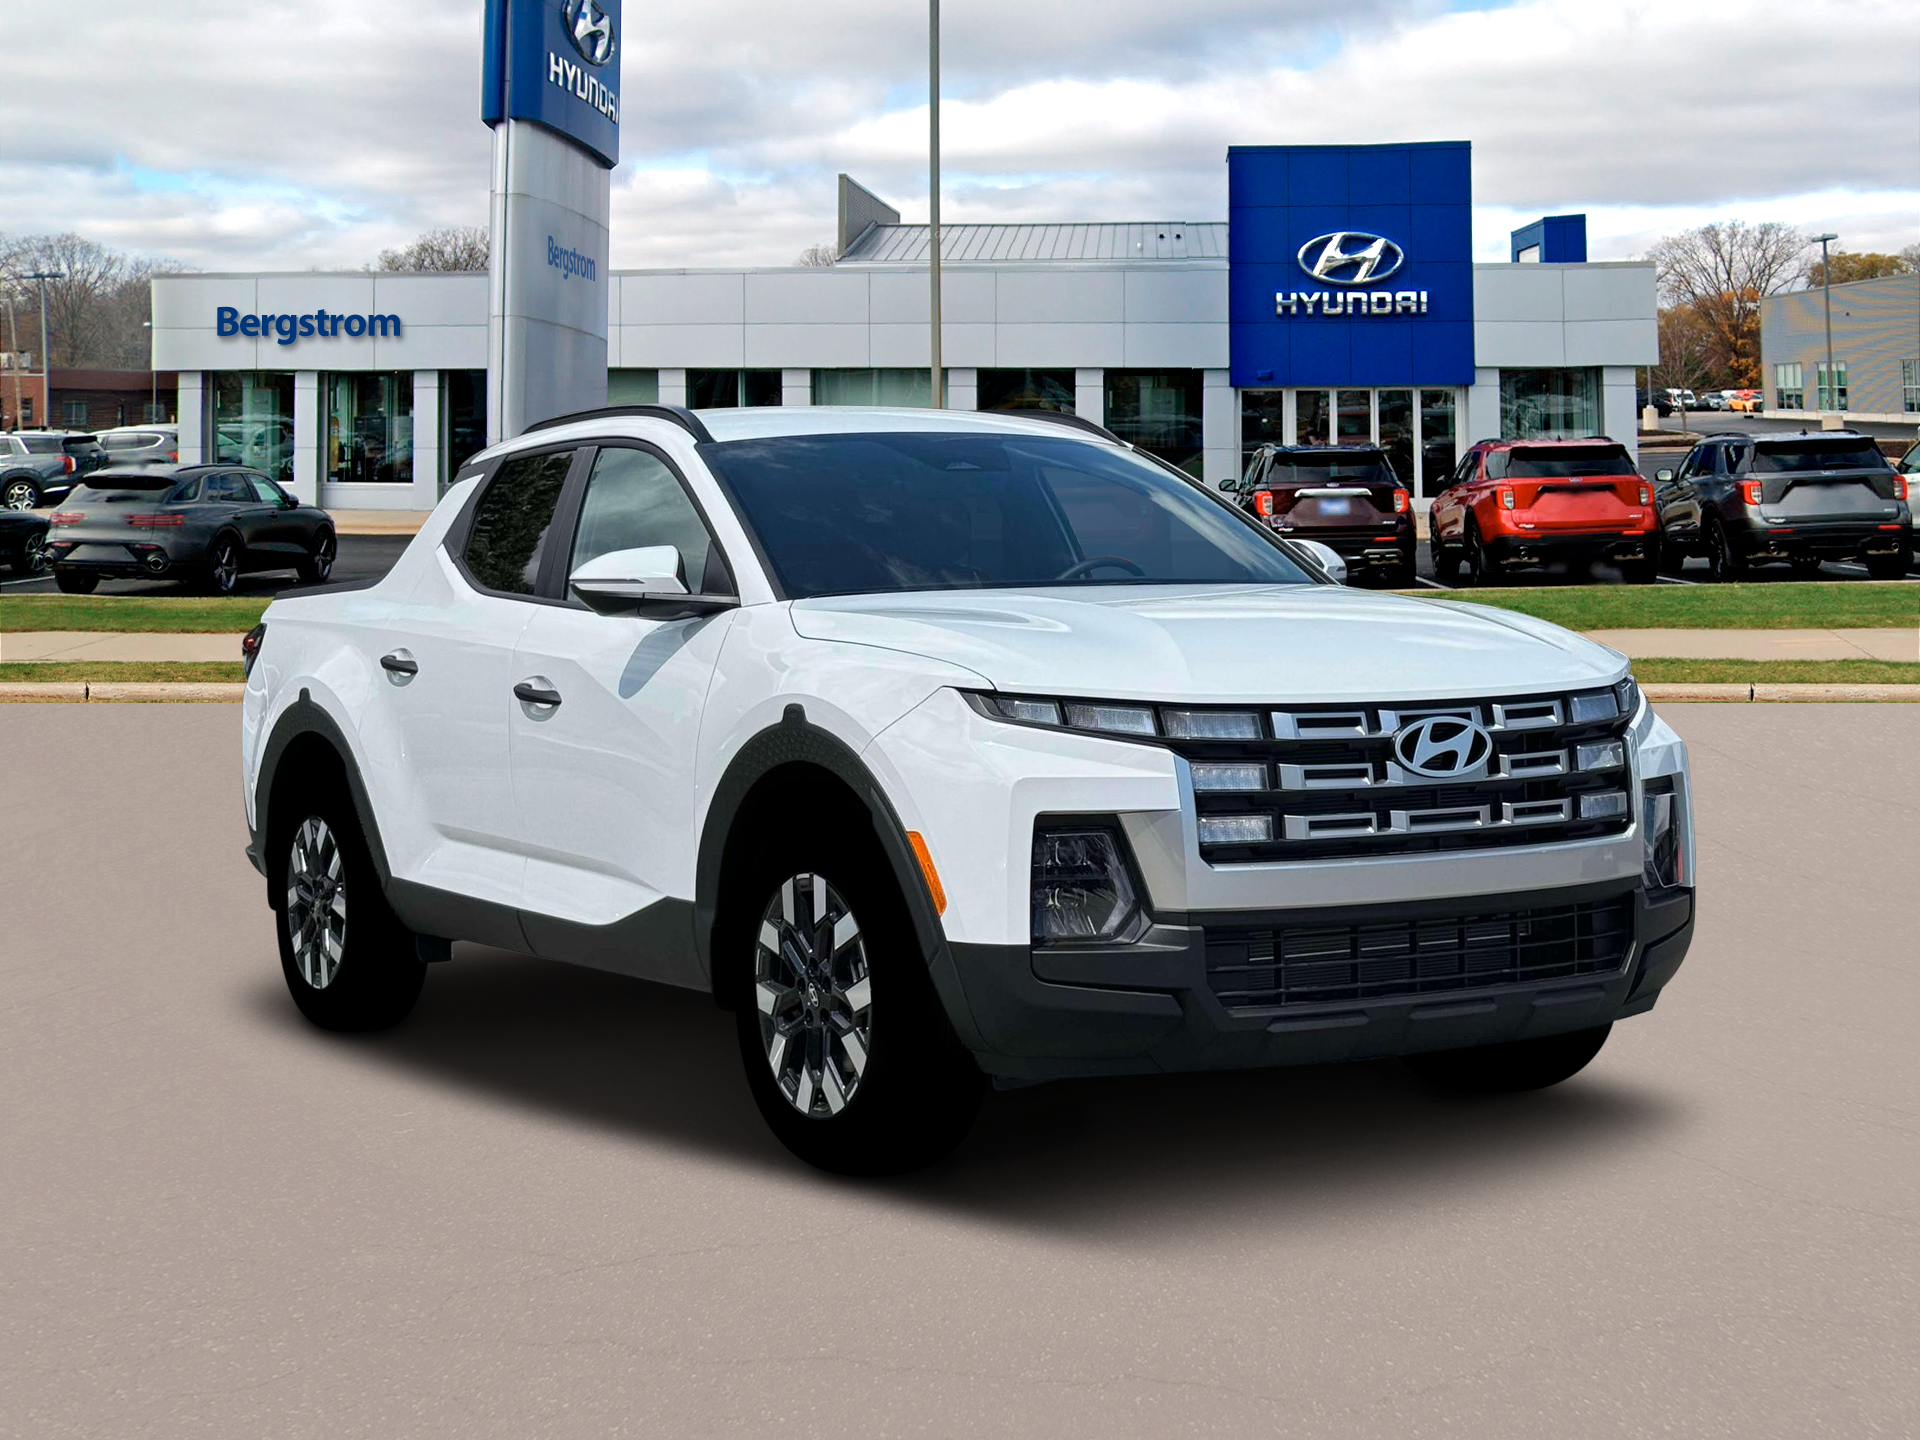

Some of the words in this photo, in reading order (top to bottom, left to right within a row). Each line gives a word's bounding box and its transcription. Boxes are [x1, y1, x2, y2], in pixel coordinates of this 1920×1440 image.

[549, 51, 619, 125] HYUNDAI
[548, 235, 596, 282] Bergstrom
[1275, 291, 1428, 315] HYUNDAI
[216, 306, 402, 346] Bergstrom
